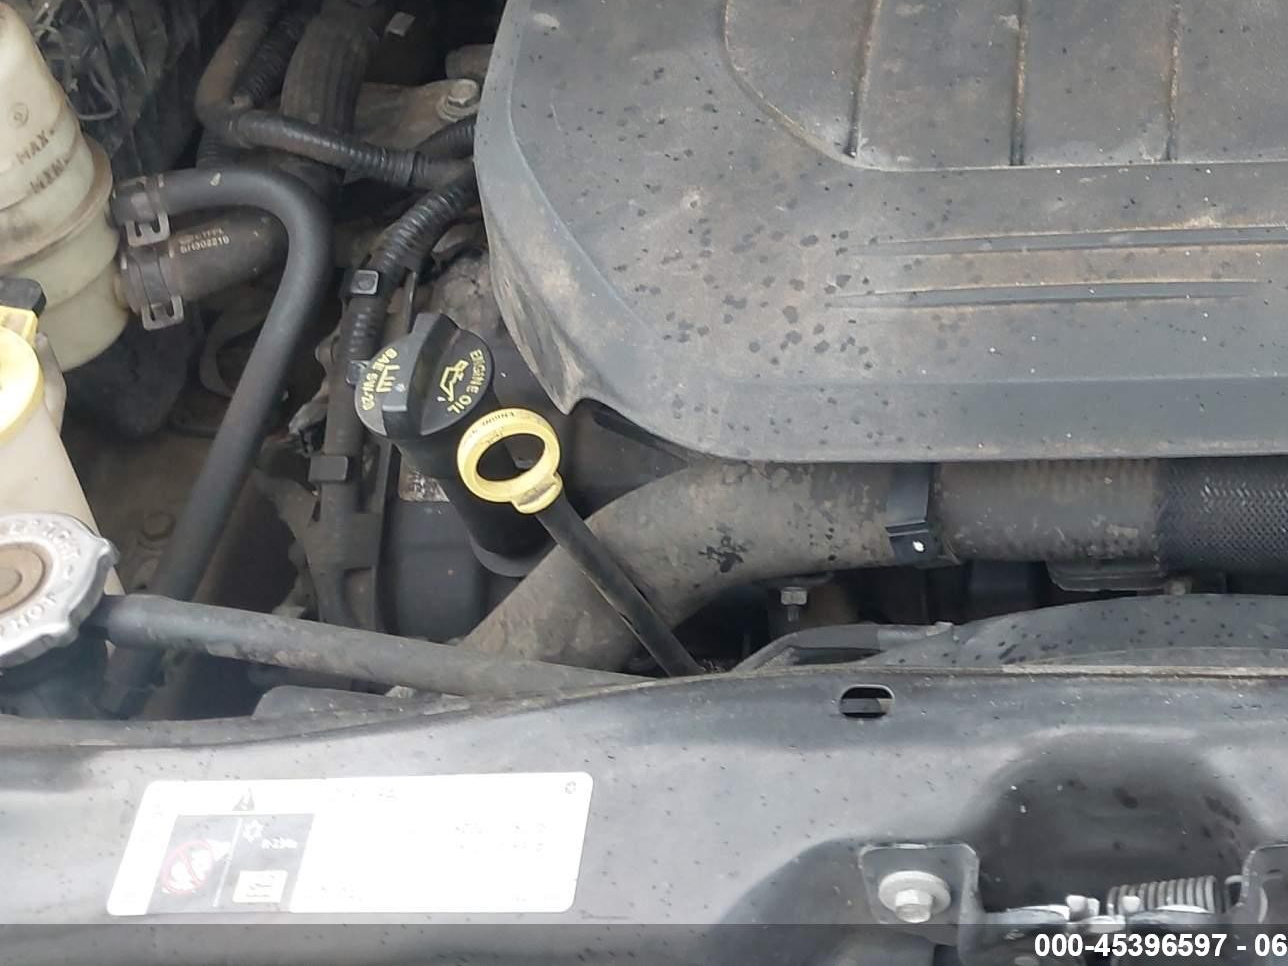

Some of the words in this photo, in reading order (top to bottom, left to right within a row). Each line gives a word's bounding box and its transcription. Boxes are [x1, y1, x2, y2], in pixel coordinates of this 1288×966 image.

[372, 348, 398, 372] SAE
[466, 349, 486, 394] ENGINE
[447, 395, 472, 414] OIL
